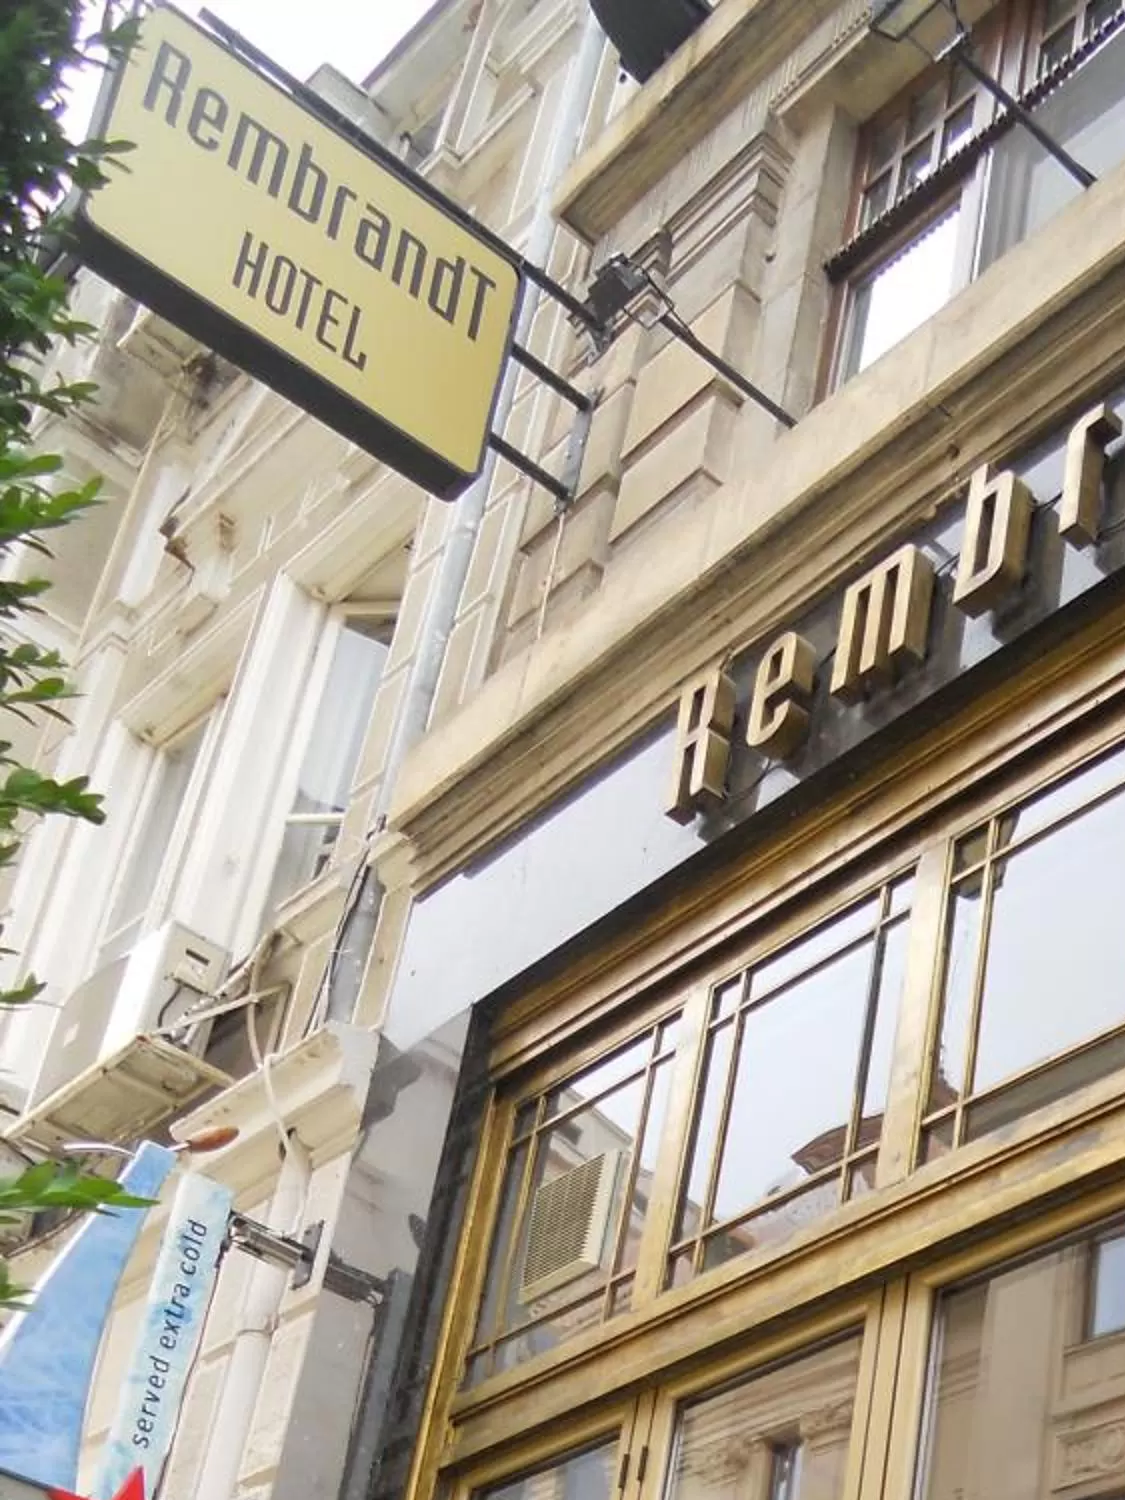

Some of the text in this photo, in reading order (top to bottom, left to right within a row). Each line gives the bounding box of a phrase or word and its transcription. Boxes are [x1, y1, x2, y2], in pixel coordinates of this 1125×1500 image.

[231, 230, 367, 372] HOTEL
[132, 1218, 208, 1450] served extra cold
